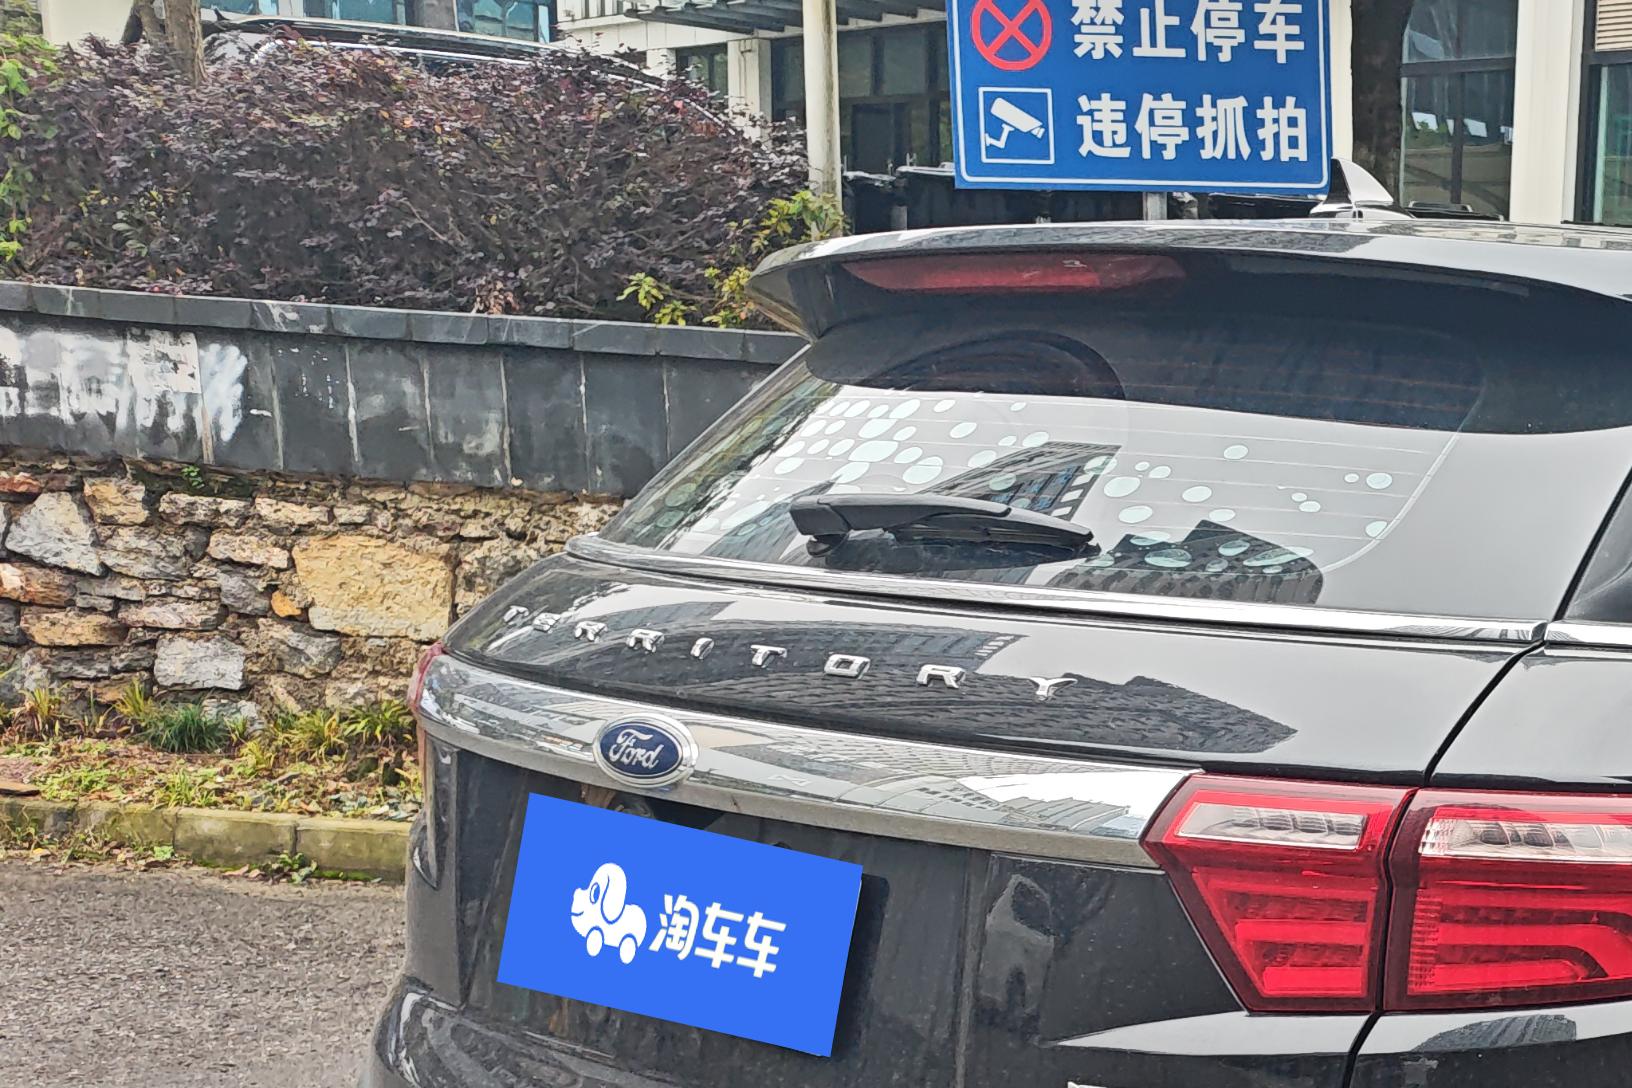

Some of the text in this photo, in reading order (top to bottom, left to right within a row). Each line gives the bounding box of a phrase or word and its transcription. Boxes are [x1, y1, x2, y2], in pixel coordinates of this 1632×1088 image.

[1071, 0, 1305, 63] 禁止停车
[1076, 93, 1308, 162] 违停抓拍
[503, 604, 1077, 699] TERRITORY
[608, 729, 664, 769] Ford
